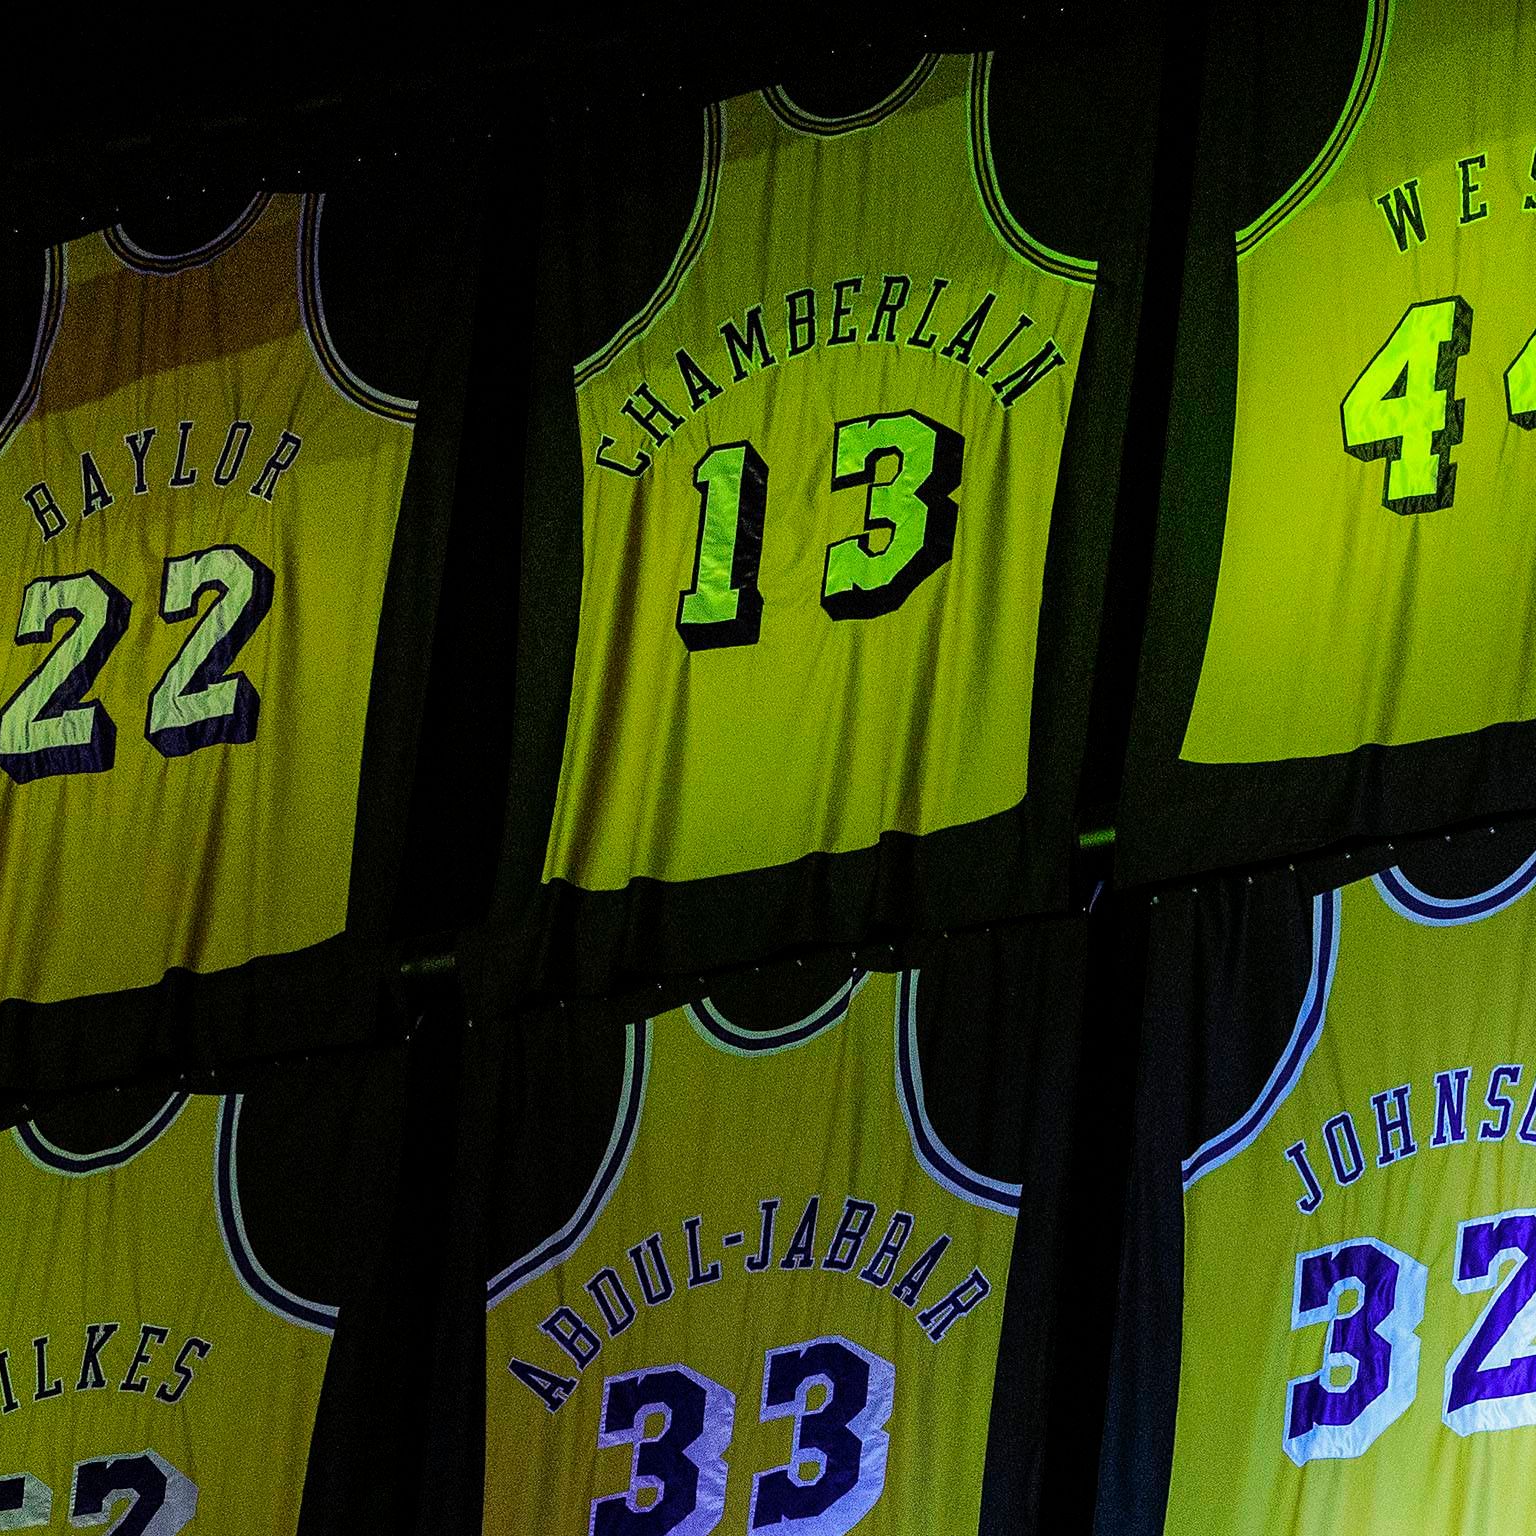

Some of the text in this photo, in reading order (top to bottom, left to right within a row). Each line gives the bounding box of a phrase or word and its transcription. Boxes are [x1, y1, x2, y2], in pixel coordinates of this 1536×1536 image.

[23, 421, 302, 543] BAYLOR
[596, 275, 1065, 479] CHAMBERLAIN
[675, 409, 965, 652] 13
[507, 1195, 992, 1413] ABDUL-JABBAR
